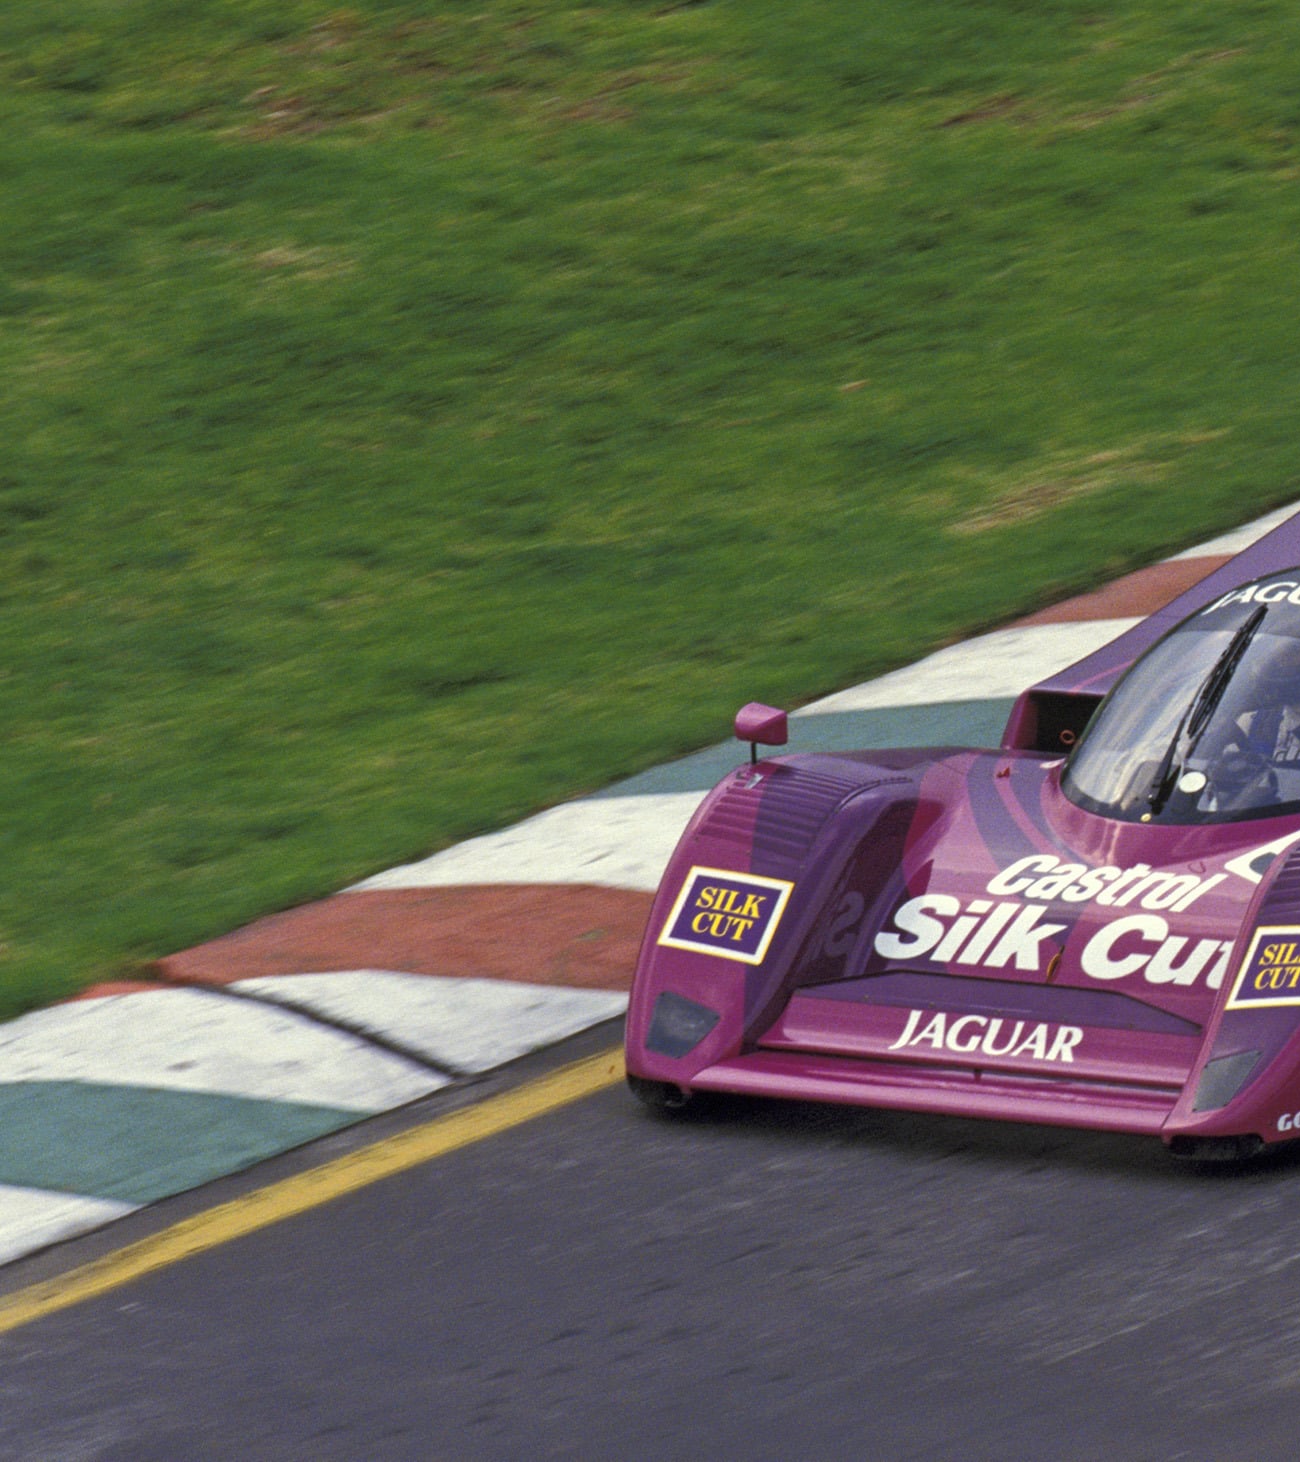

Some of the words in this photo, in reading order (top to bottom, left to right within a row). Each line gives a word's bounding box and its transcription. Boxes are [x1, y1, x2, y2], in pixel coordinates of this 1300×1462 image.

[695, 886, 767, 919] SILK
[986, 854, 1228, 913] Castrol
[691, 912, 753, 941] CUT
[874, 893, 1068, 971] Silk
[888, 1009, 1084, 1063] JAGUAR
